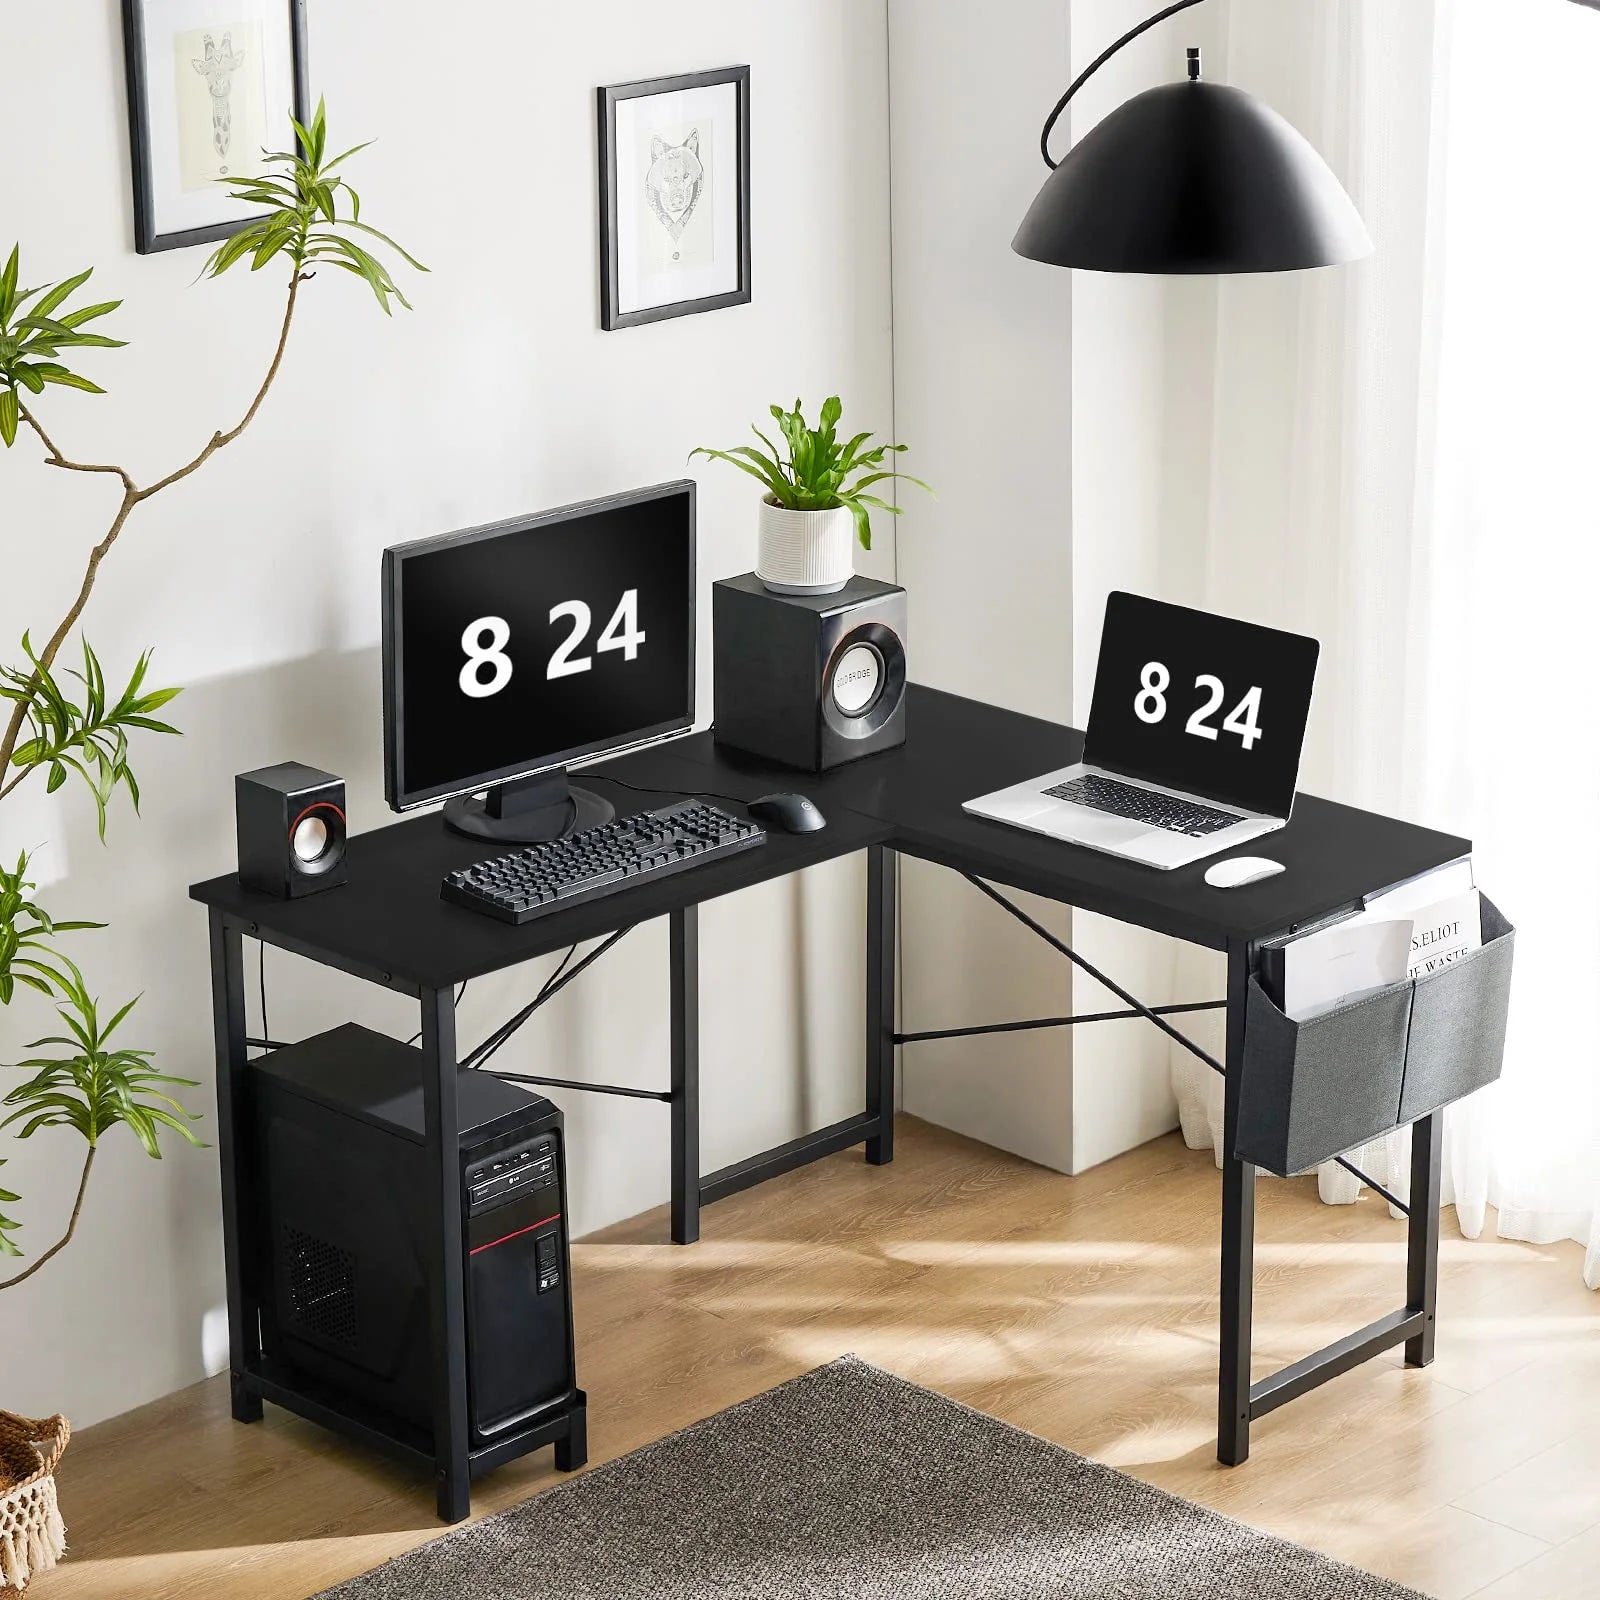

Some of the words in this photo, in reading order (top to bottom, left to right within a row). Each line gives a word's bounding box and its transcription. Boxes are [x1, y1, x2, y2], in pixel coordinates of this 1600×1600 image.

[458, 615, 513, 698] 8
[546, 588, 646, 681] 24
[1133, 661, 1171, 724] 8
[1184, 674, 1263, 751] 24
